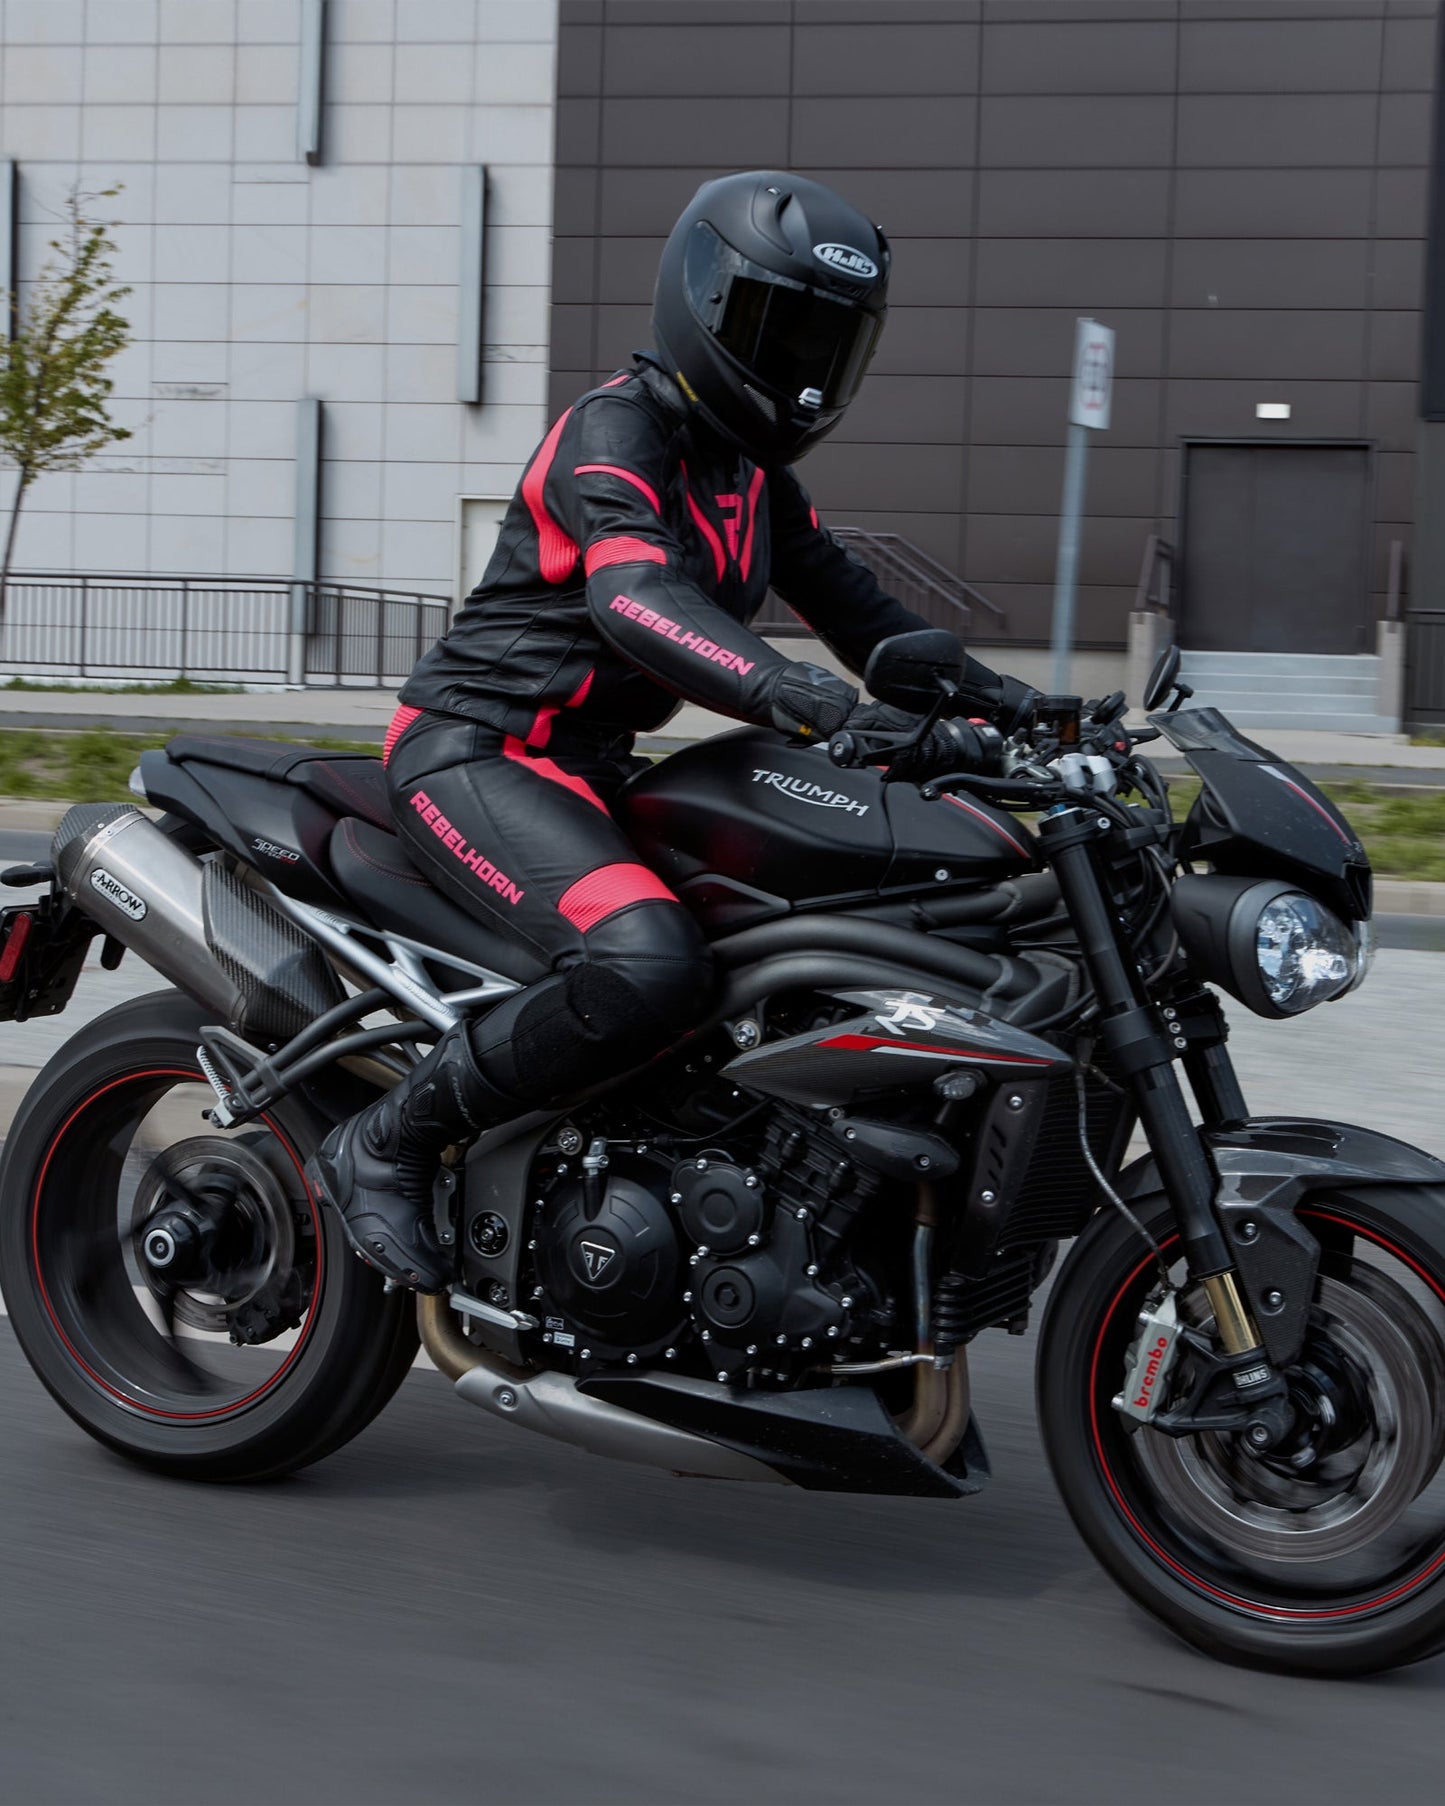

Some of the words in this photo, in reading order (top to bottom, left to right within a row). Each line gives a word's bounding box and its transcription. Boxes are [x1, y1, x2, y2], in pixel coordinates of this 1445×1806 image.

[823, 246, 873, 274] HJC
[609, 594, 756, 676] REBELHORN
[751, 769, 870, 816] TRIUMPH
[251, 838, 300, 861] SPEED
[409, 790, 525, 905] REBELHORN
[96, 874, 142, 911] ARROW
[1133, 1336, 1169, 1408] brembo
